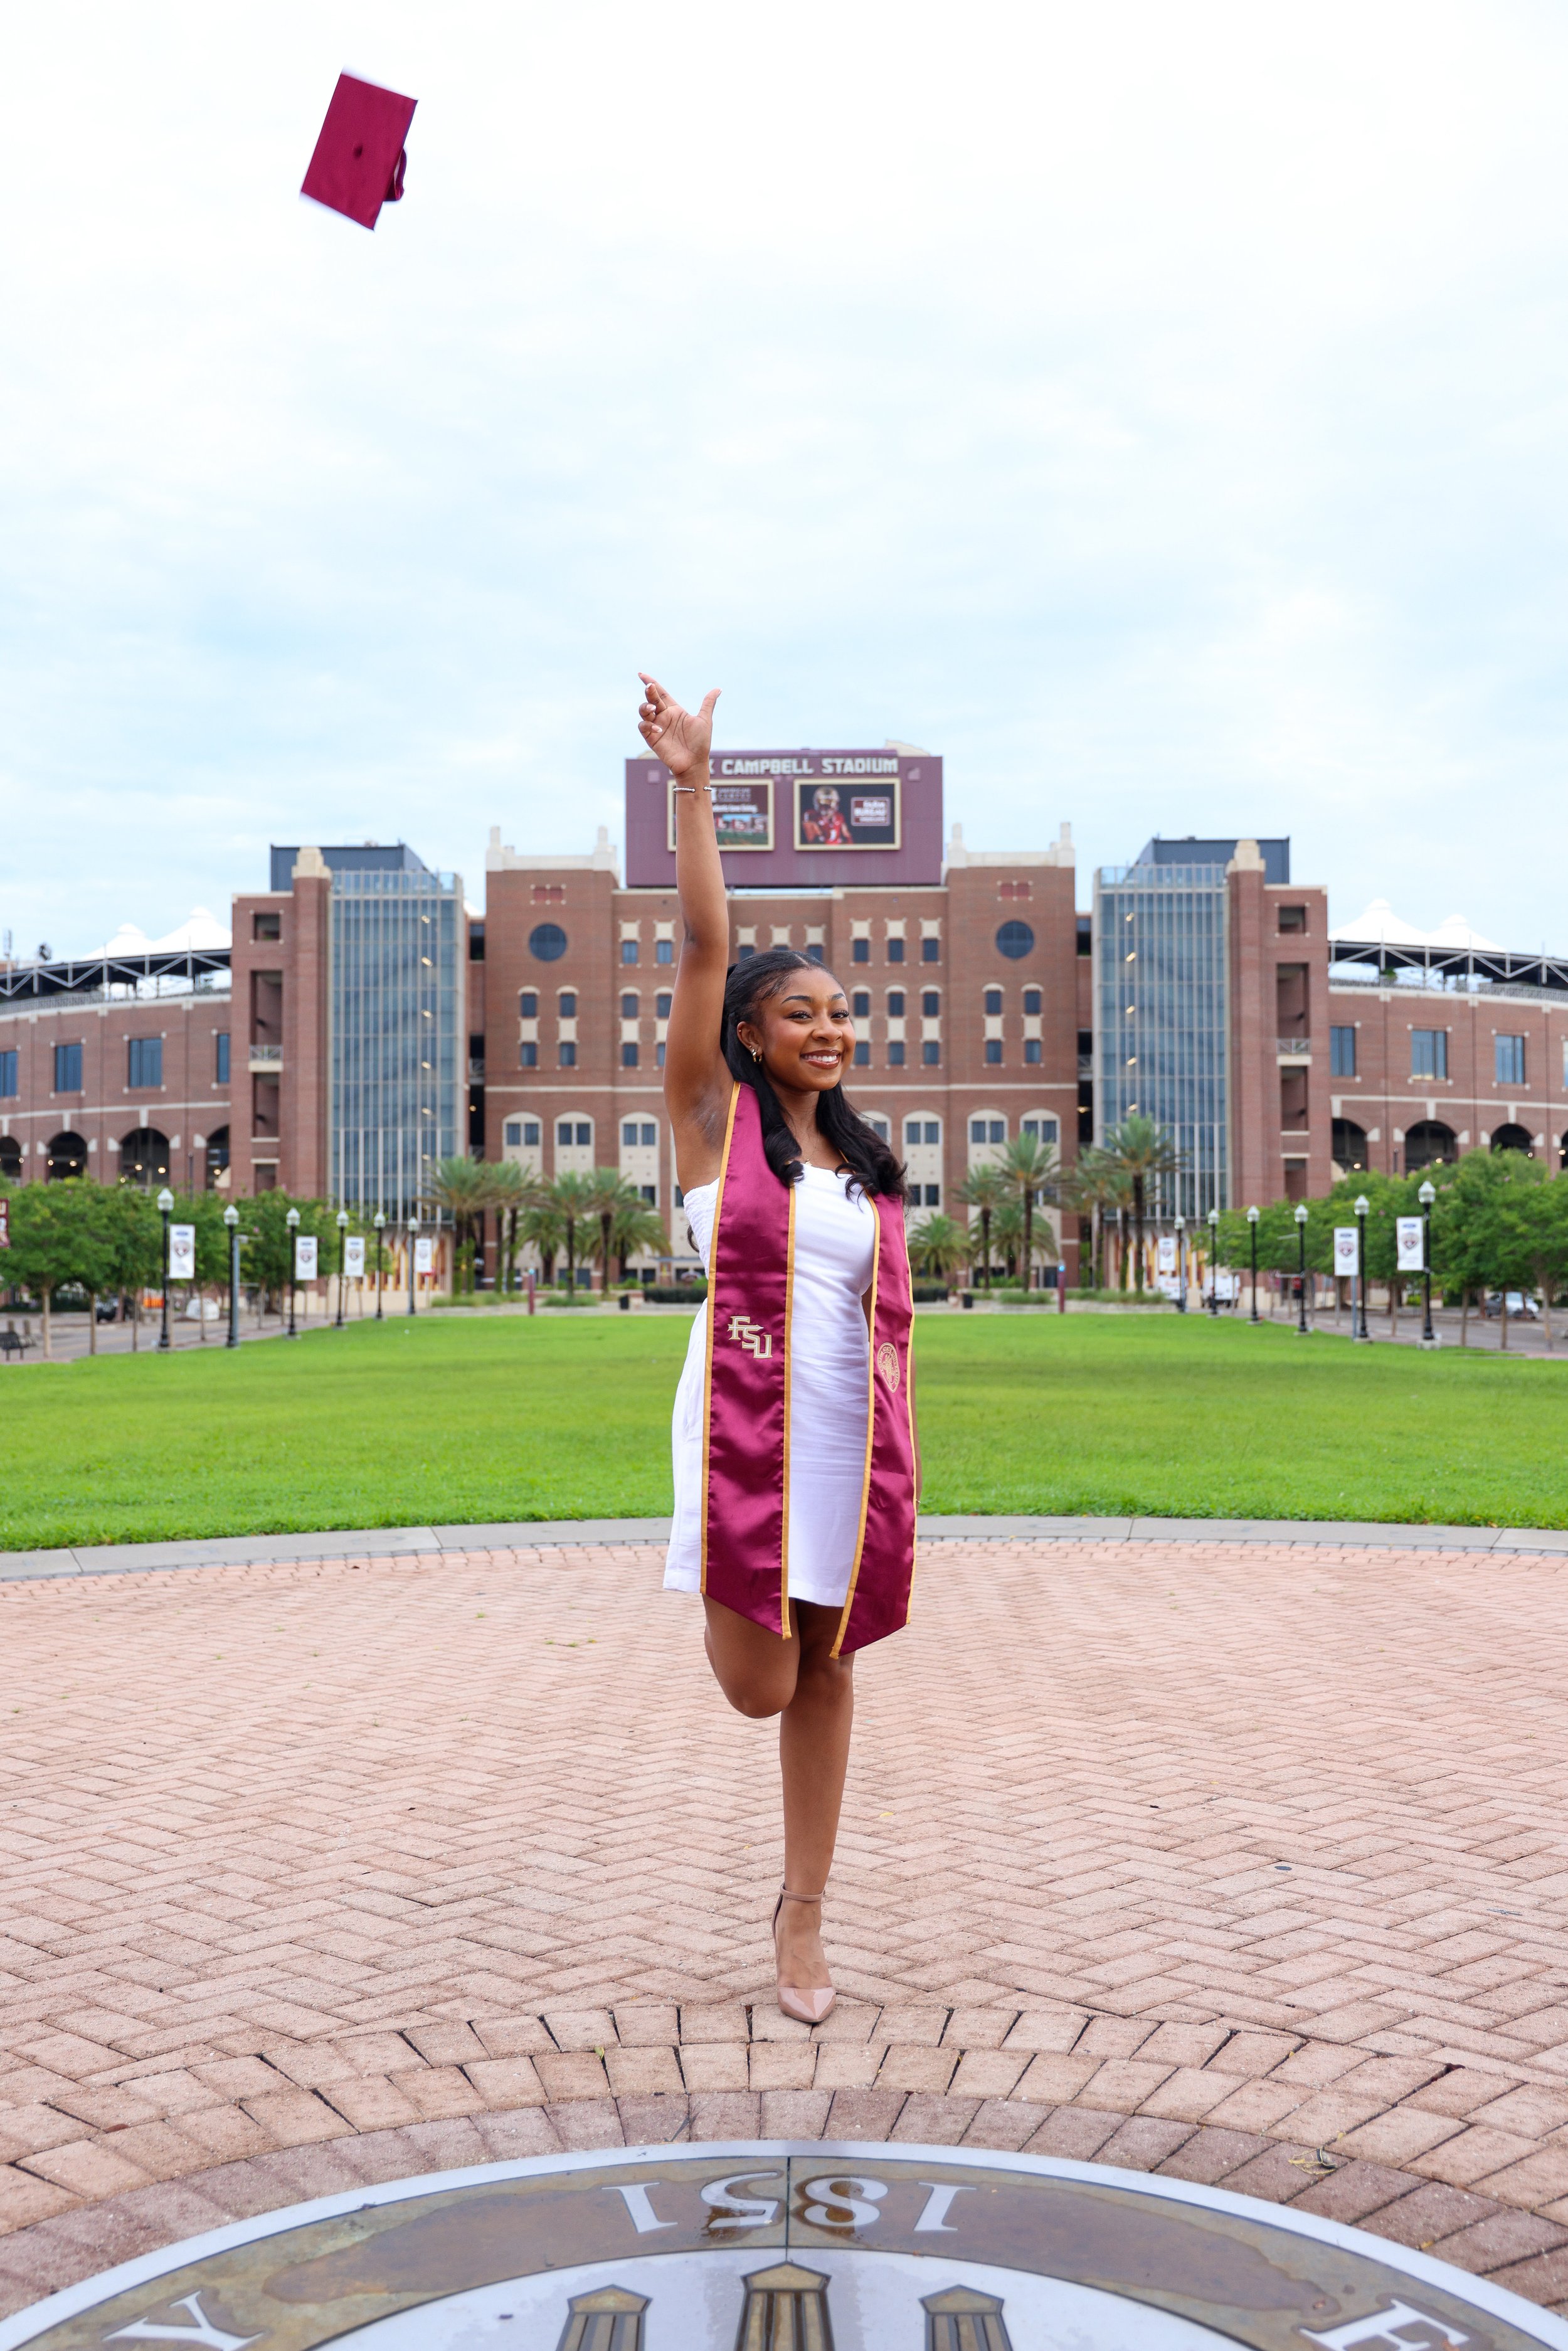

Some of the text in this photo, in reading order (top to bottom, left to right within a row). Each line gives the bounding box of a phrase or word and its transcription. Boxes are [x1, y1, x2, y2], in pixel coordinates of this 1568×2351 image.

[721, 758, 814, 775] CAMPBELL
[822, 757, 898, 774] STADIUM
[728, 1315, 773, 1359] FSU
[601, 2170, 977, 2234] 1851
